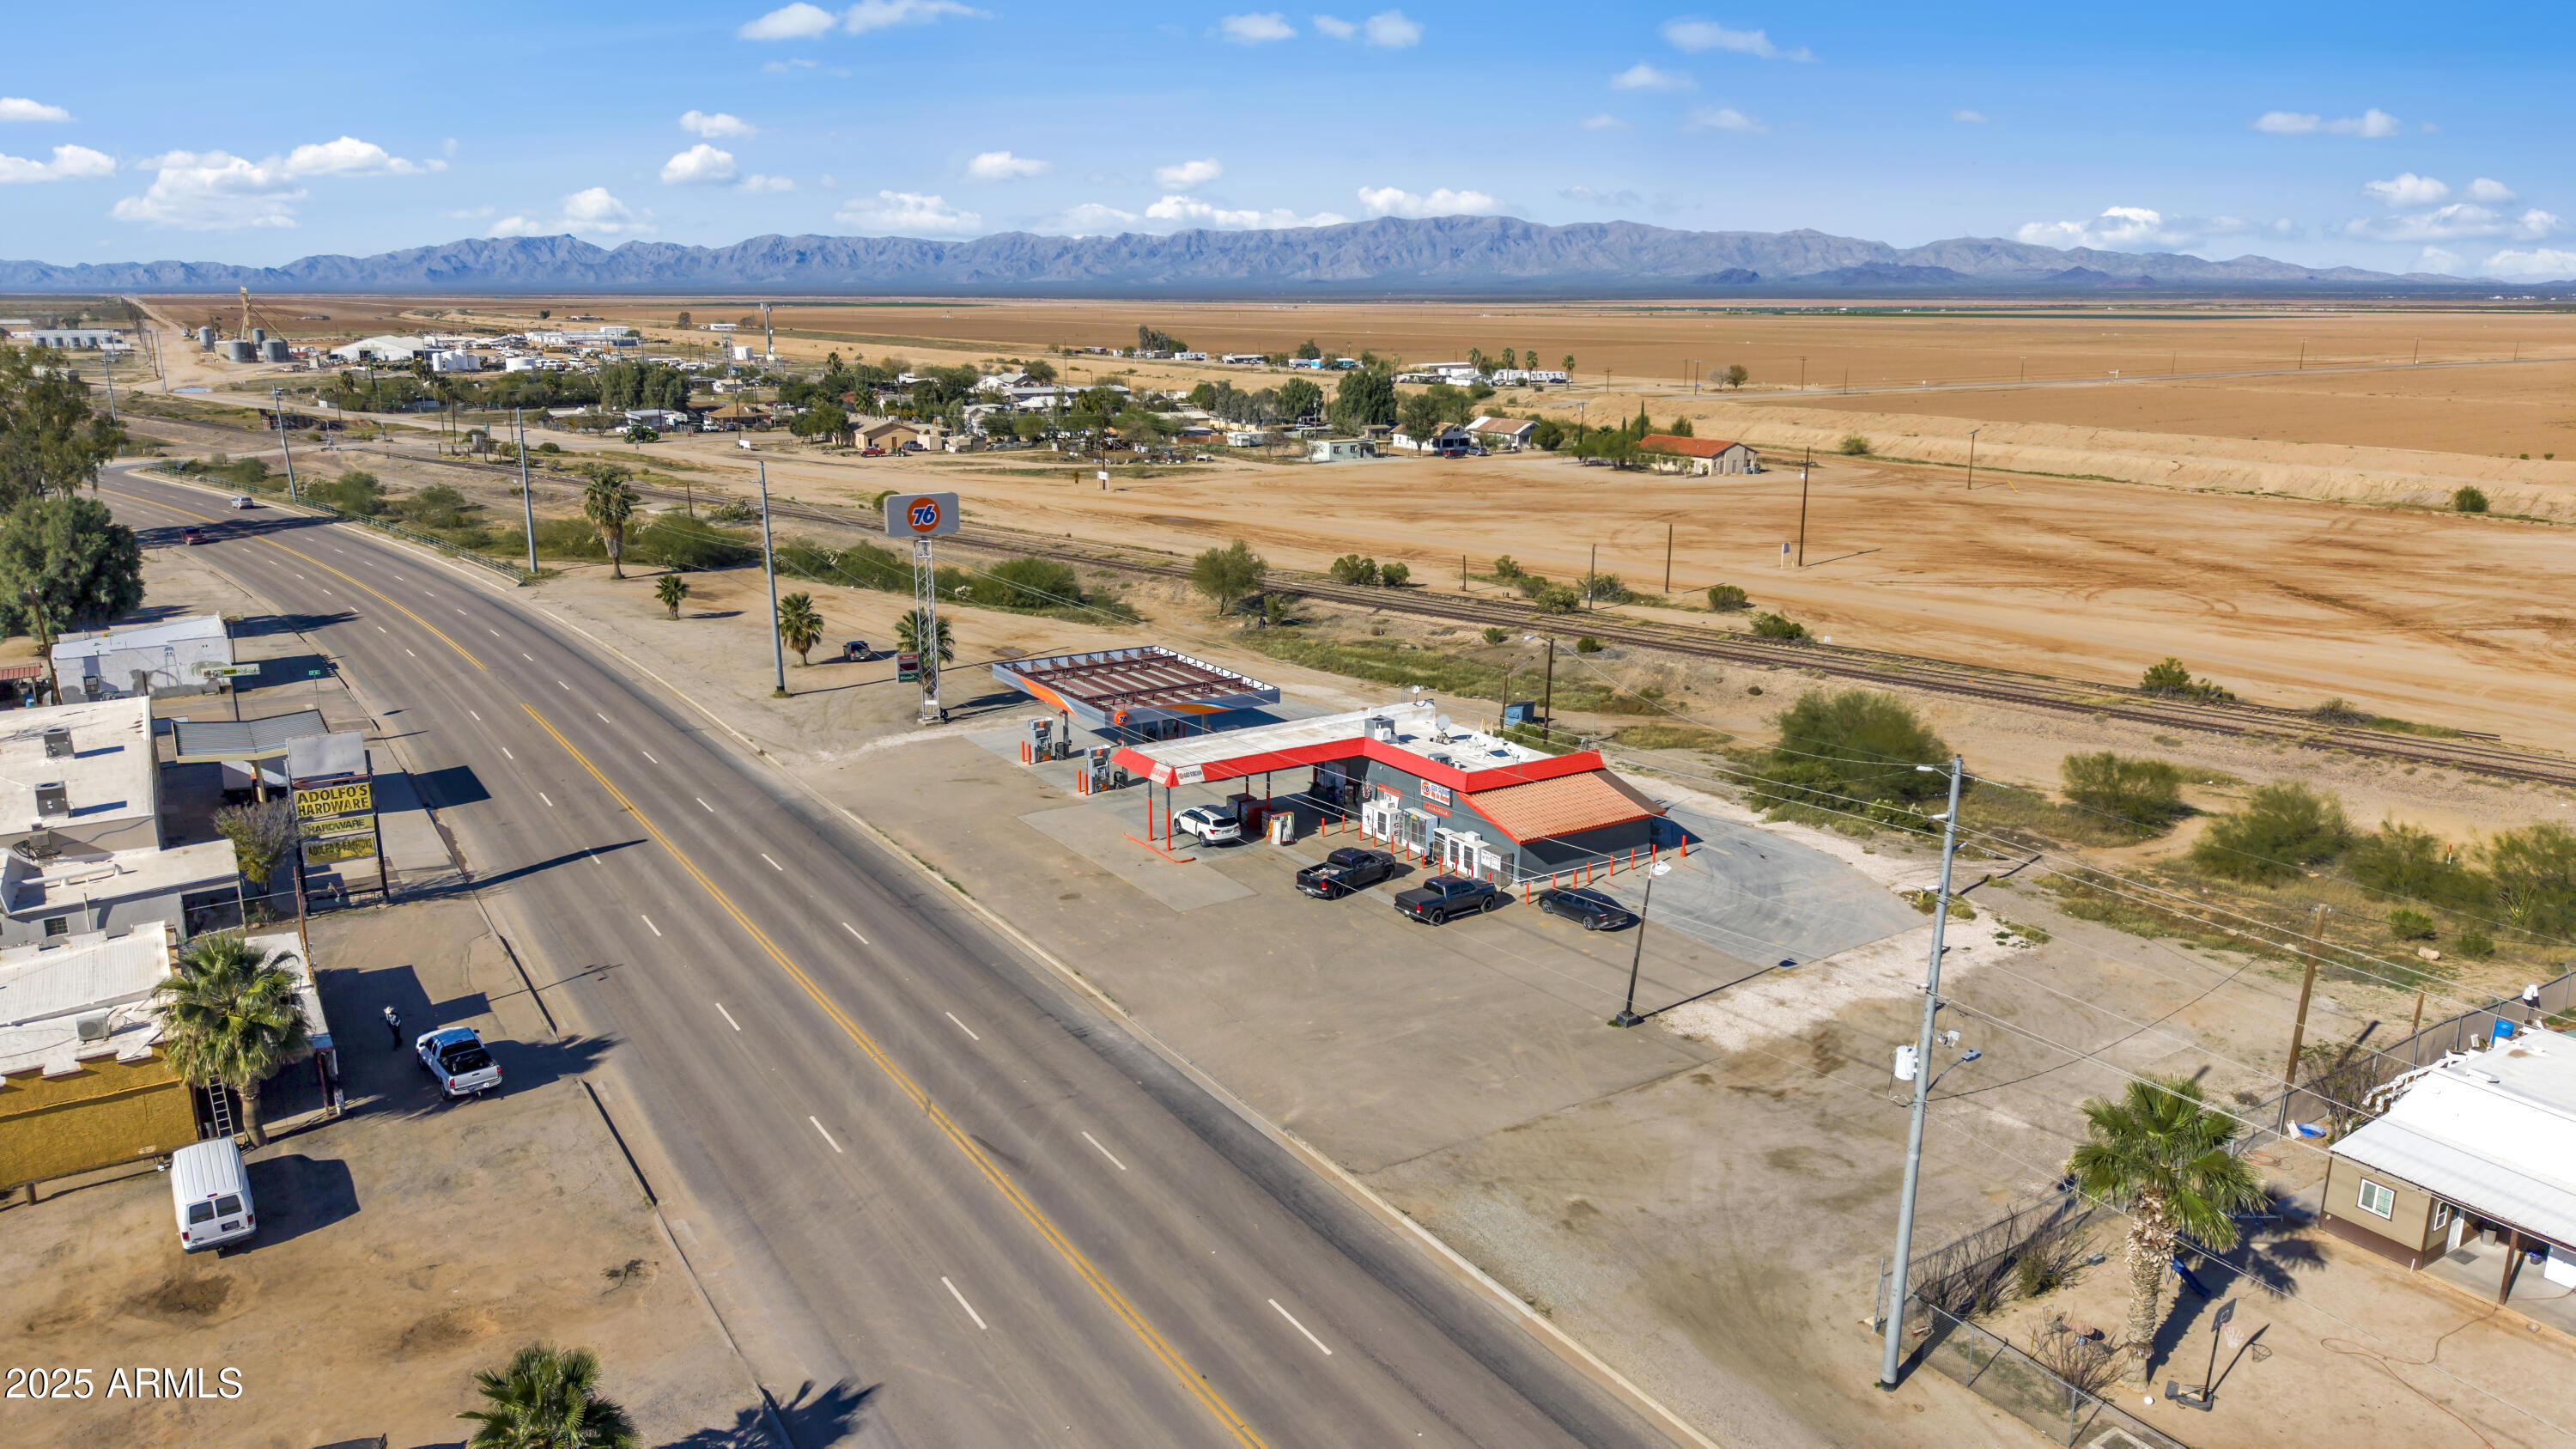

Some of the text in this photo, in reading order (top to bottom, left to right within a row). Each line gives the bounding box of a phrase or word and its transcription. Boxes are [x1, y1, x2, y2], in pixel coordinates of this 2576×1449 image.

[912, 503, 936, 526] 76
[1119, 714, 1127, 722] 76
[297, 784, 368, 804] ADOLFO'S
[297, 796, 369, 817] HARDWARE
[307, 819, 365, 833] HARDWARE
[308, 841, 341, 856] ADOLFO'S
